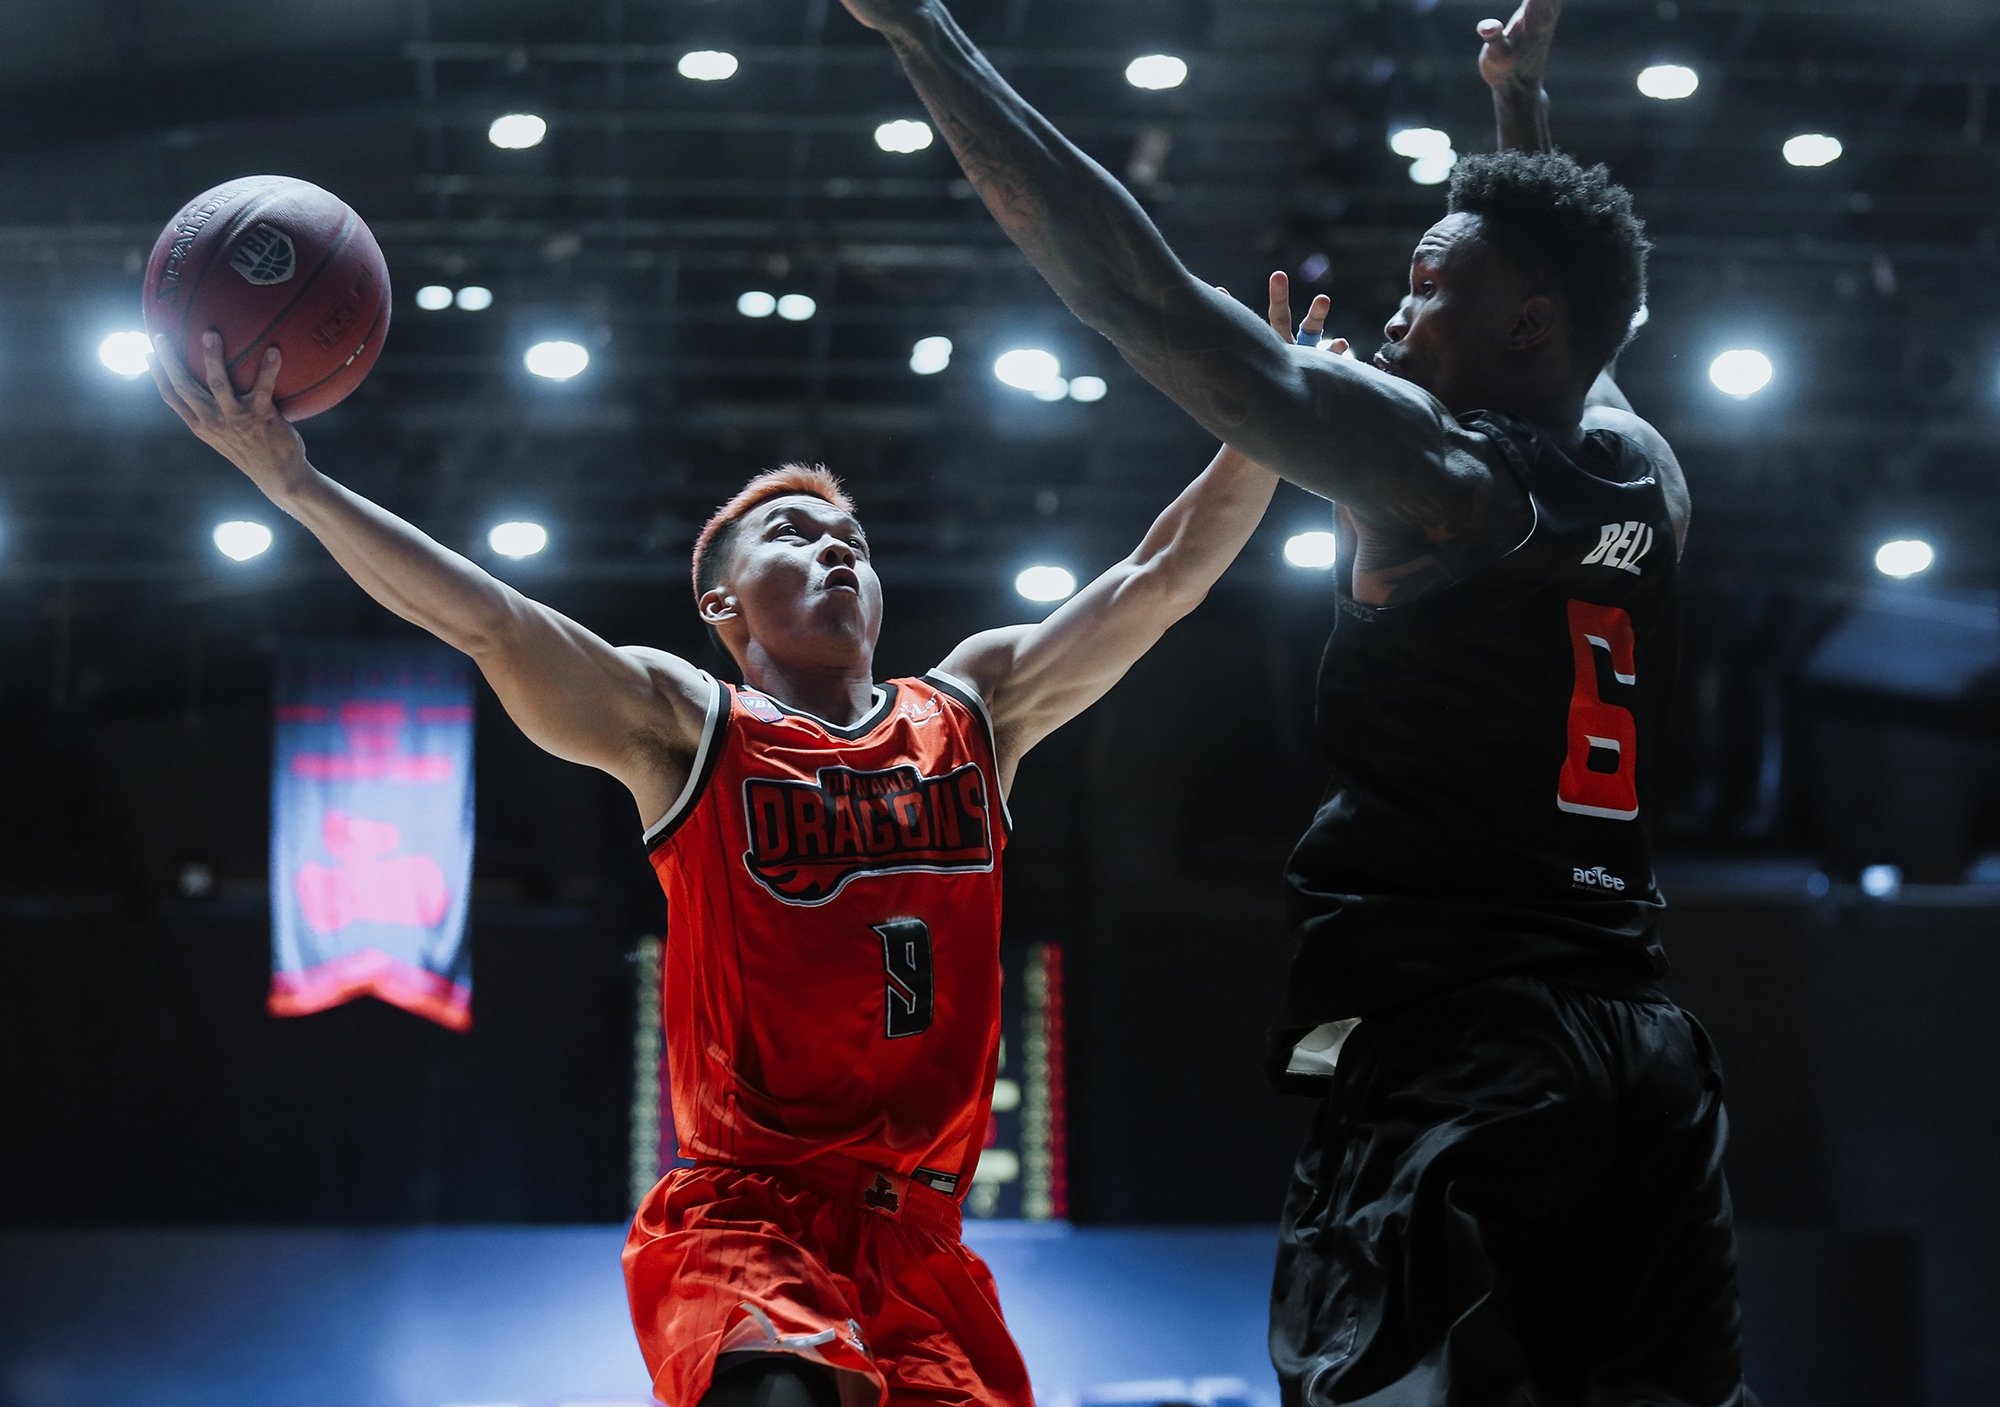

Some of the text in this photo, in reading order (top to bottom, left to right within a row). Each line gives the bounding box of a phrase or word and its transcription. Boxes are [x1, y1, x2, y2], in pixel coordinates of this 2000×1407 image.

[233, 227, 278, 268] VBA
[1581, 520, 1654, 576] BELL
[1556, 598, 1639, 822] 6
[751, 772, 988, 861] DRAGONS
[868, 914, 935, 1040] 9
